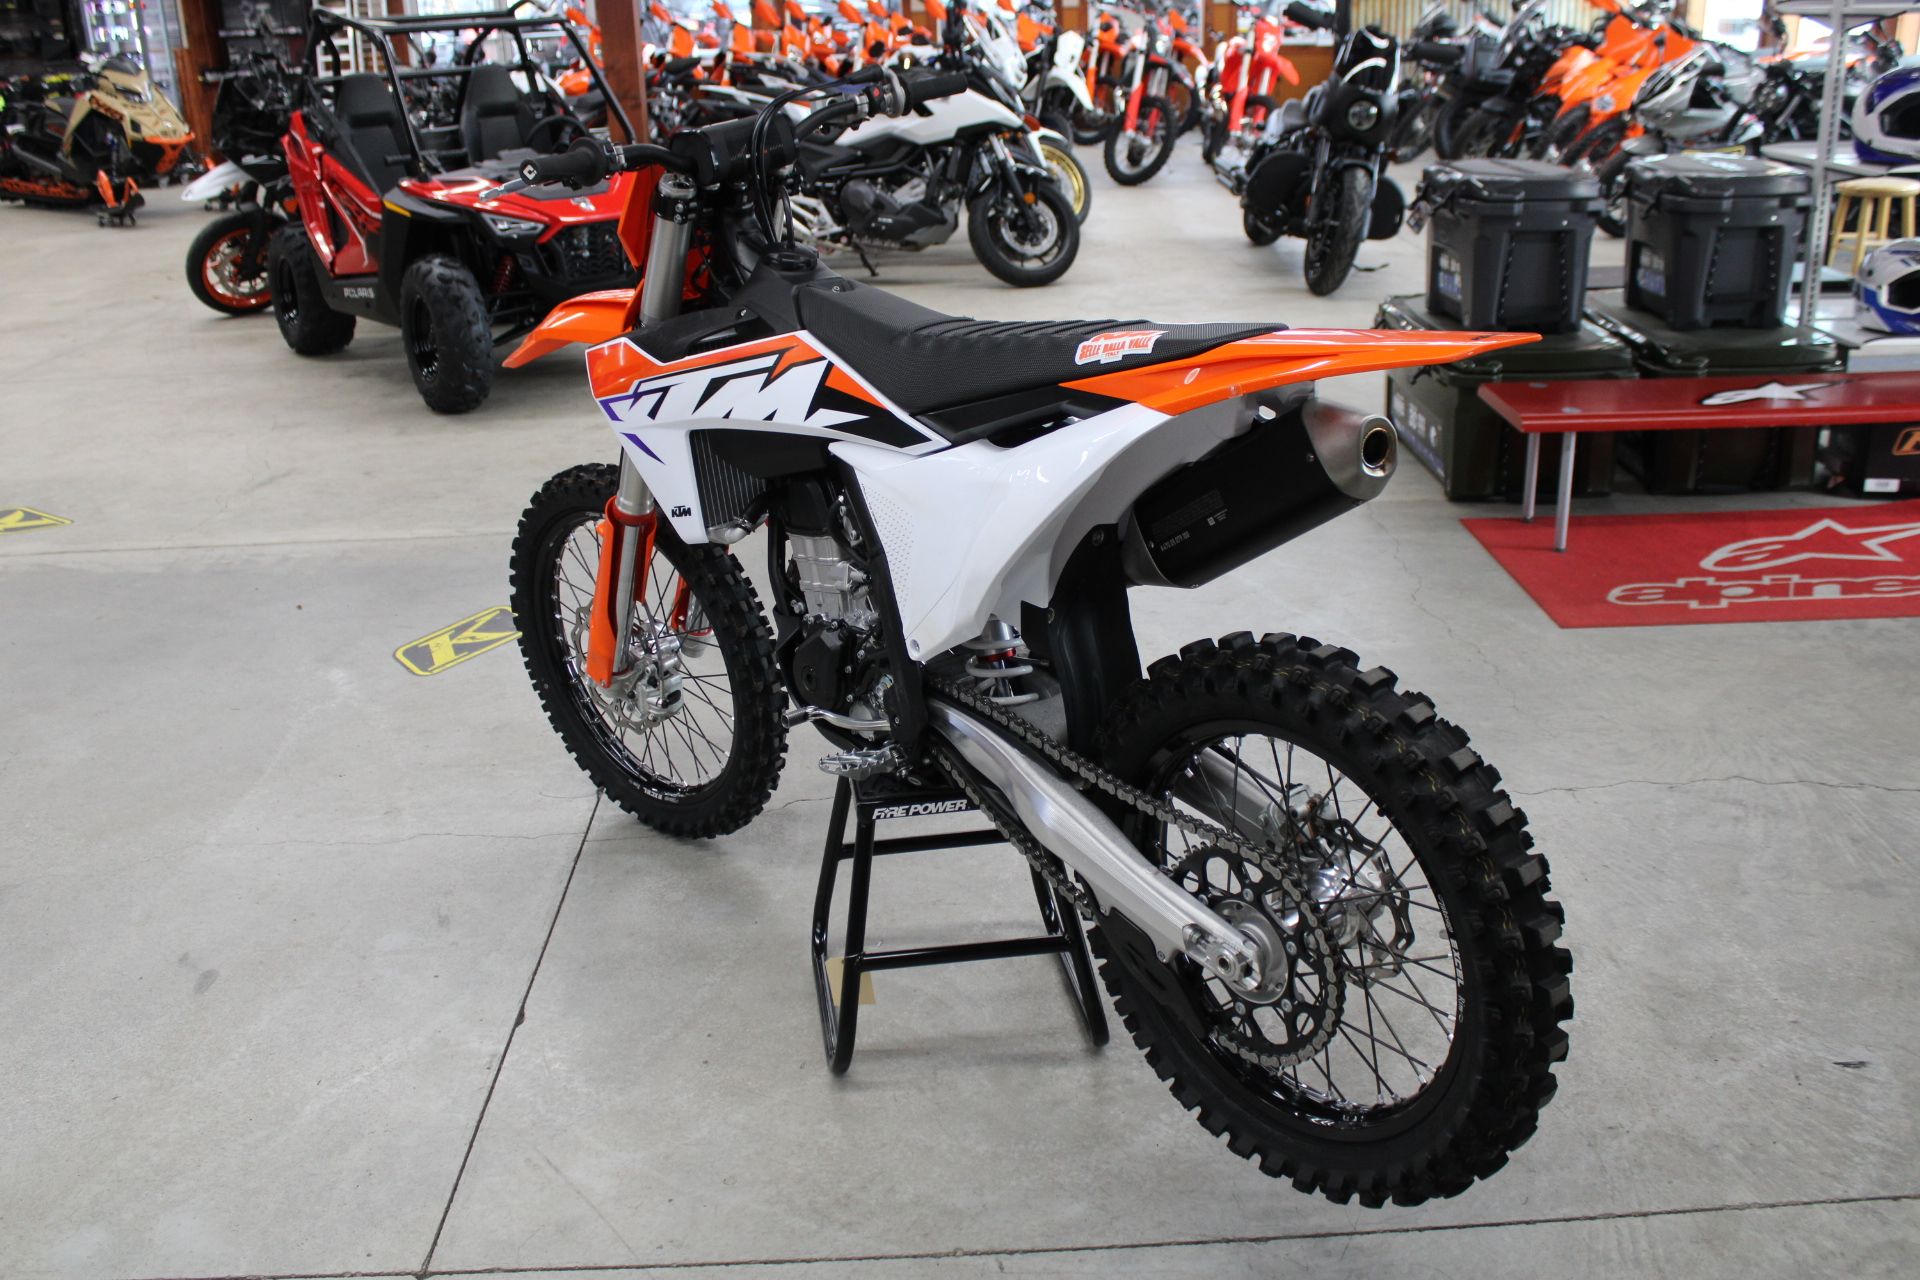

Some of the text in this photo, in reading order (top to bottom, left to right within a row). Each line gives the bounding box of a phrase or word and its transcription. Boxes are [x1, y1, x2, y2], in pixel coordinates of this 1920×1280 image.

[343, 287, 375, 299] POLARIS
[600, 353, 868, 440] KTM
[671, 505, 692, 518] KTM
[872, 799, 968, 820] FIRE POWER
[1449, 937, 1465, 988] EXCEL
